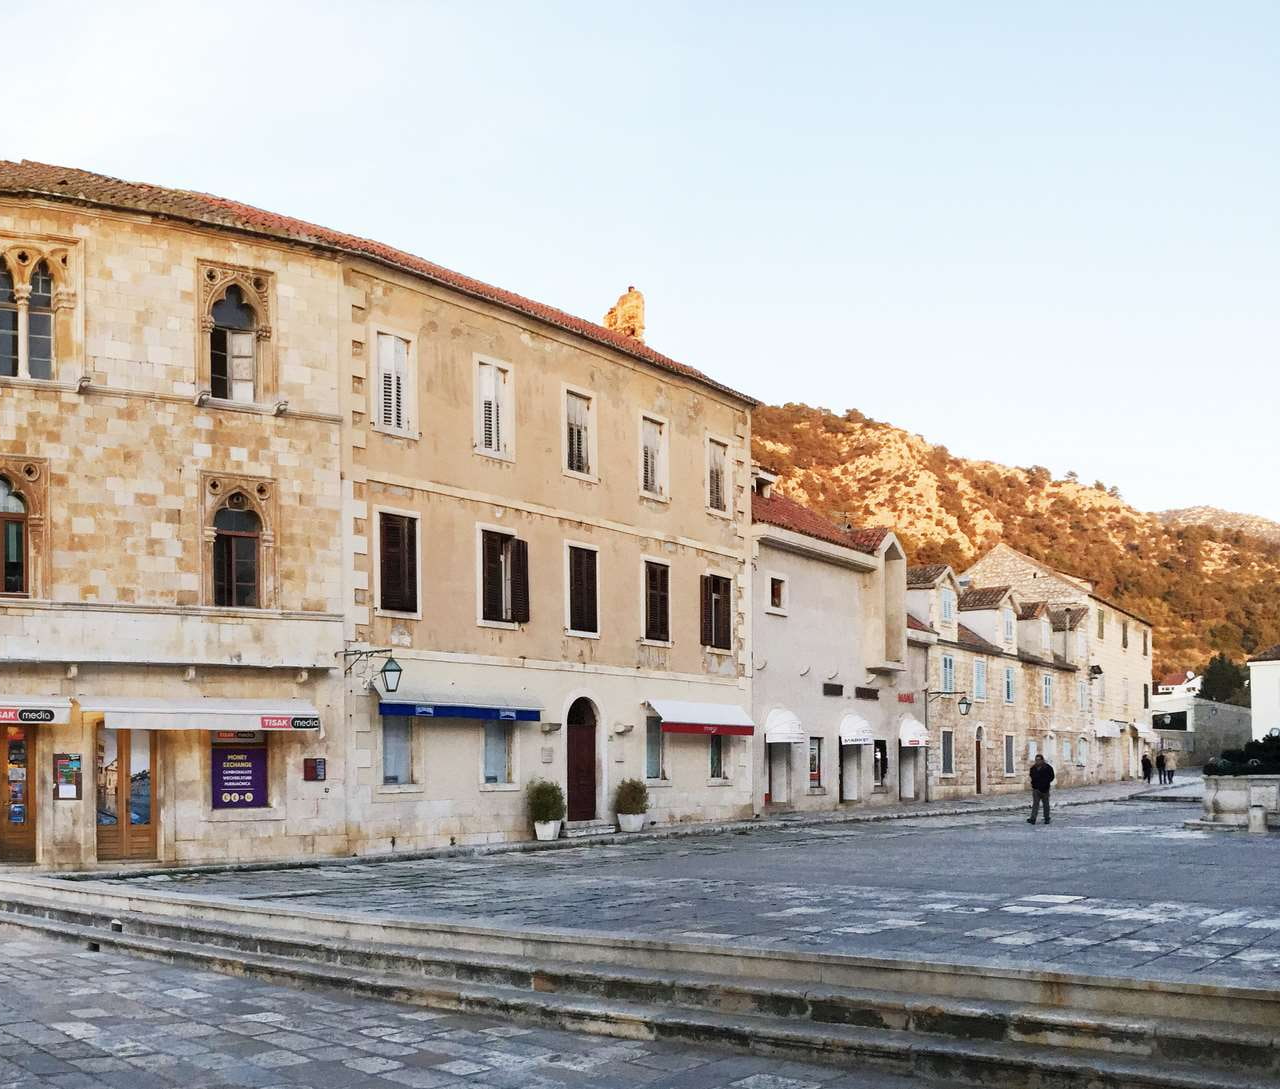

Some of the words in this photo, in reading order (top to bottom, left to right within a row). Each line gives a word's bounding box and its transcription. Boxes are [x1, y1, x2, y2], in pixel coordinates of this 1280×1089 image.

[22, 711, 51, 720] media
[264, 719, 288, 728] TISAK
[294, 719, 319, 728] media
